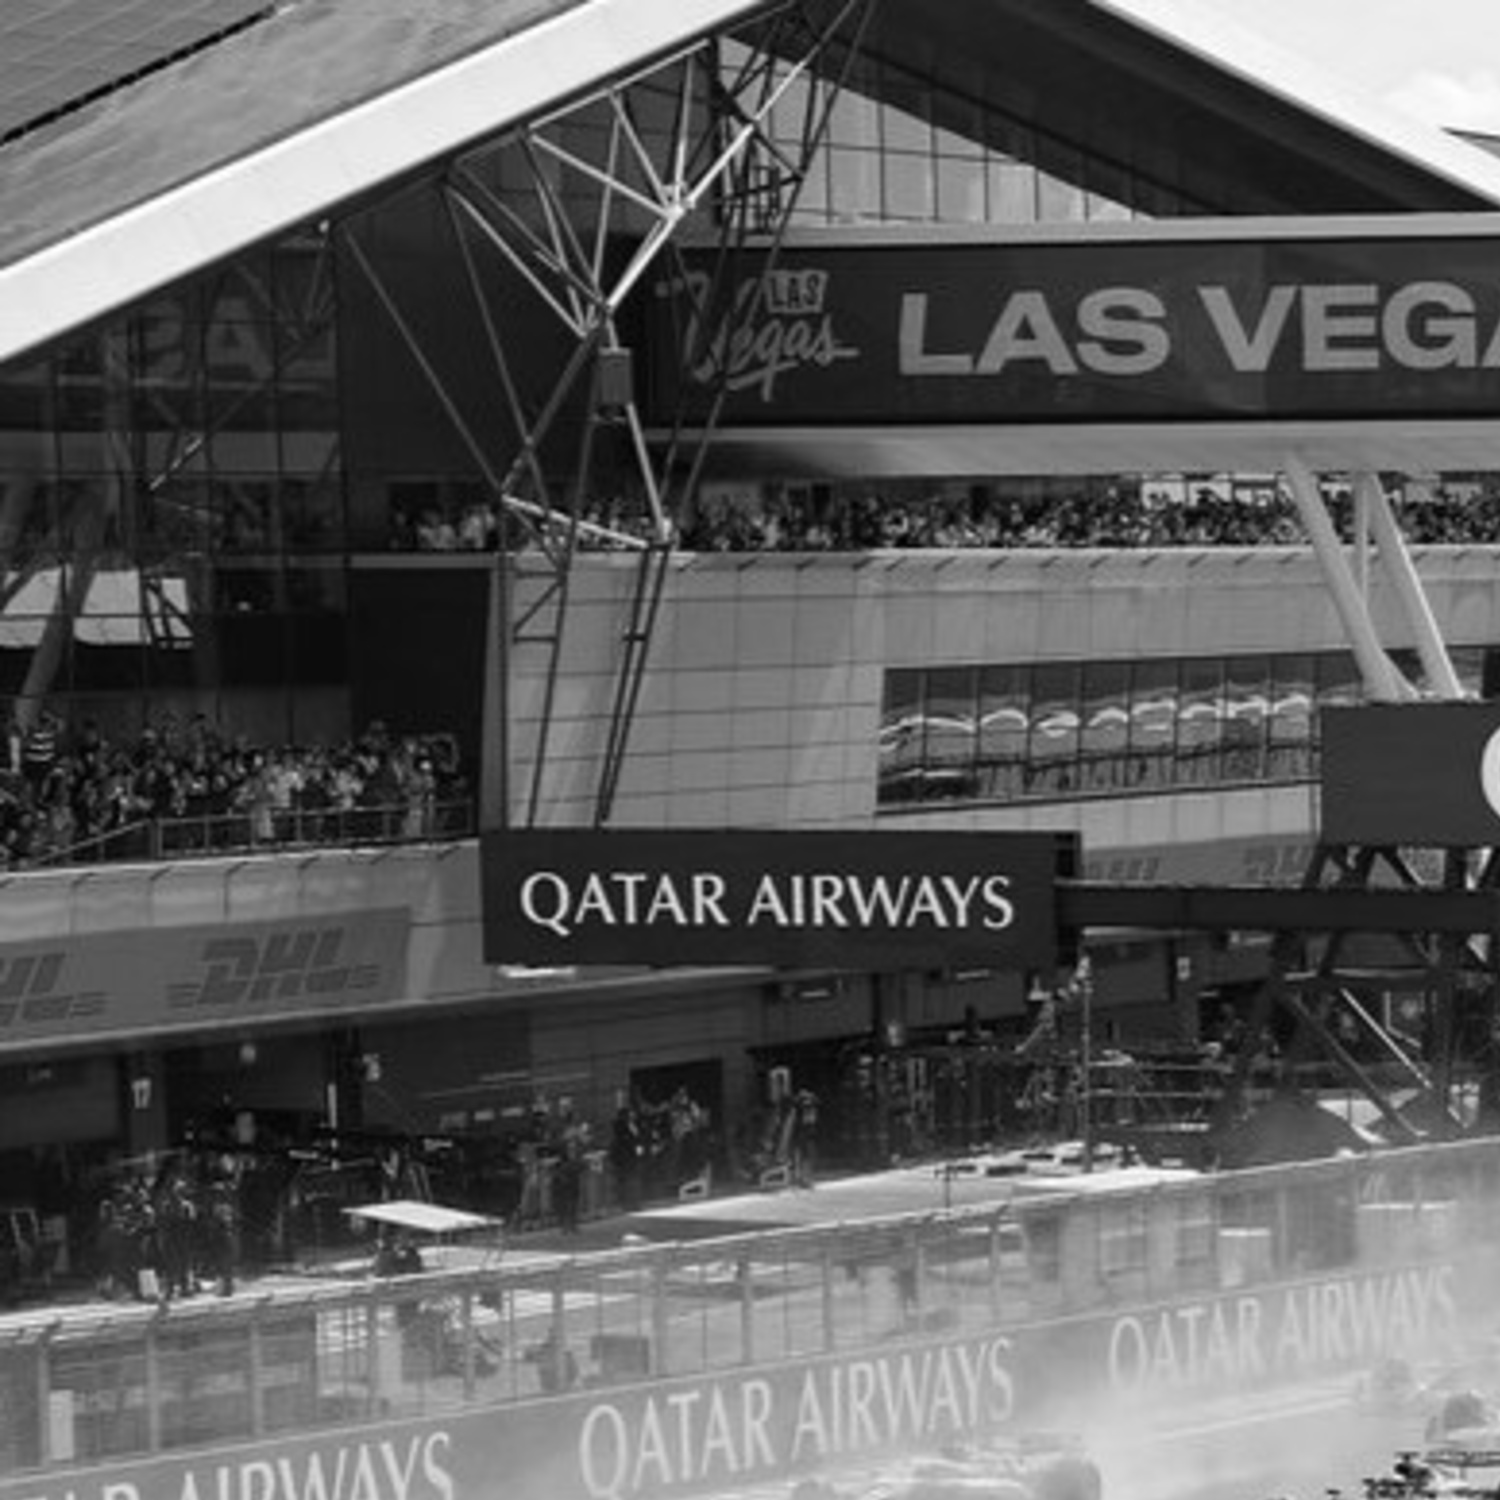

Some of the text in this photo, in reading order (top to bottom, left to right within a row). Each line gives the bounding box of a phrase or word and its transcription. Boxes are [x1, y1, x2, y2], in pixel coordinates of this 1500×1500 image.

[901, 288, 1170, 375] LAS
[520, 873, 1014, 936] QATAR AIRWAYS
[192, 927, 353, 1004] DHL
[1108, 1265, 1456, 1391] QATAR AIRWAYS
[791, 1337, 1017, 1461] AIRWAYS
